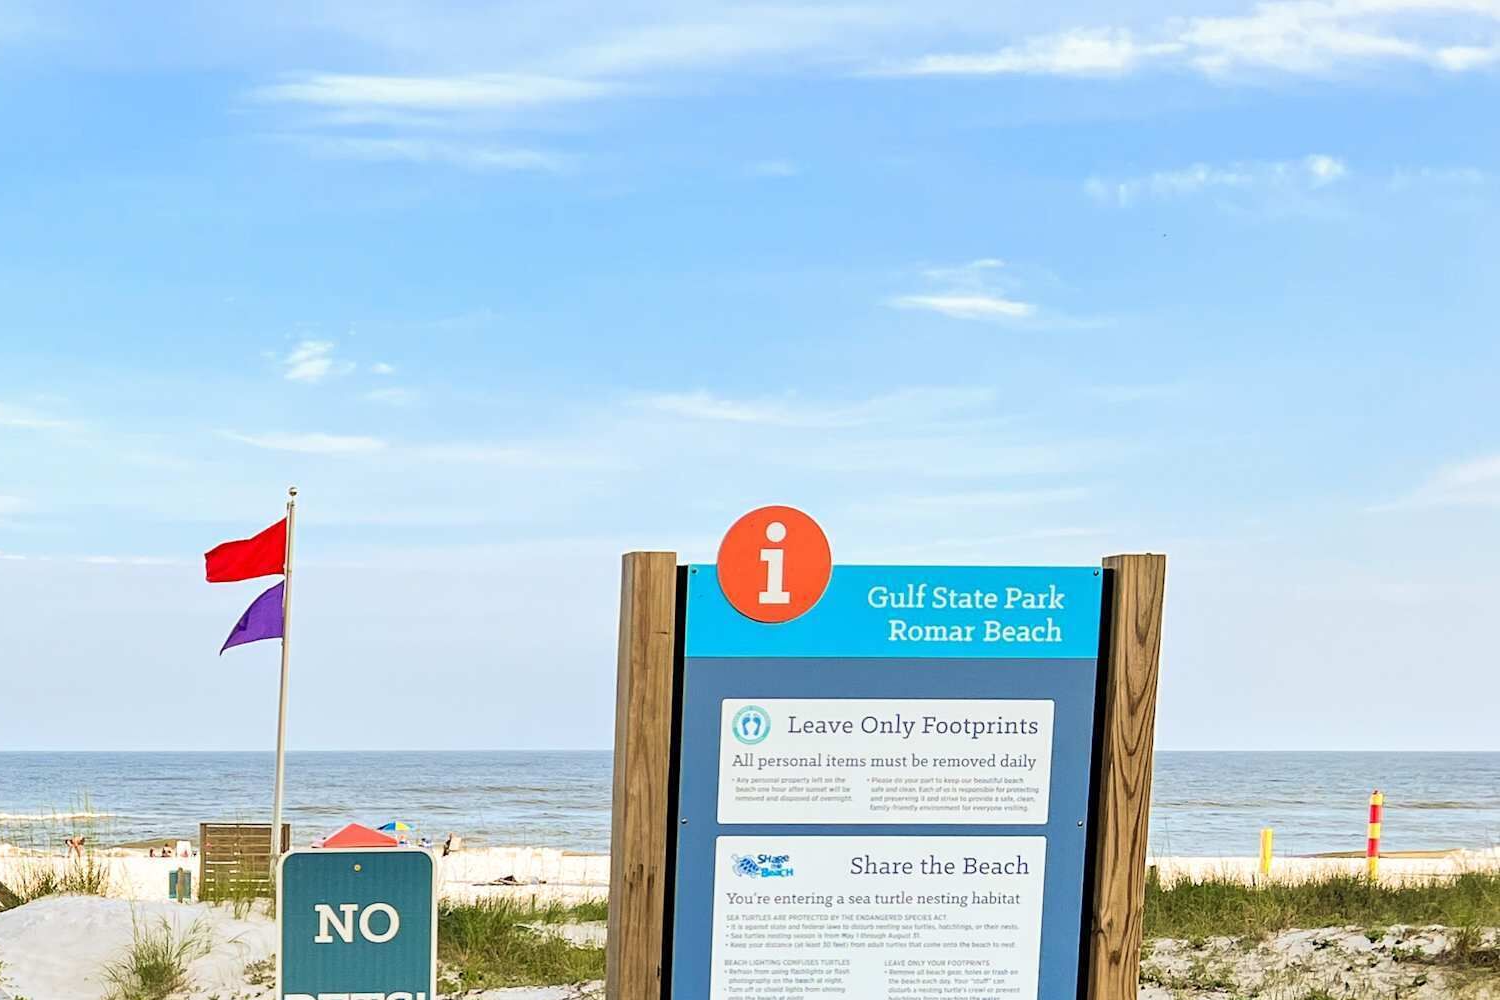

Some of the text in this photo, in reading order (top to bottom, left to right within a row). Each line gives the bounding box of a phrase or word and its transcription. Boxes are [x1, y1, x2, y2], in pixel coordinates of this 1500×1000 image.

[867, 583, 1065, 609] Gulf State Park
[888, 617, 1062, 642] Romar Beach
[787, 713, 1038, 740] Leave Only Footprints
[732, 753, 1037, 771] All personal items must be removed daily
[850, 854, 1029, 875] Share the Beach
[726, 891, 1020, 908] You're entering a sea turtle nesting habitat
[314, 903, 400, 943] NO
